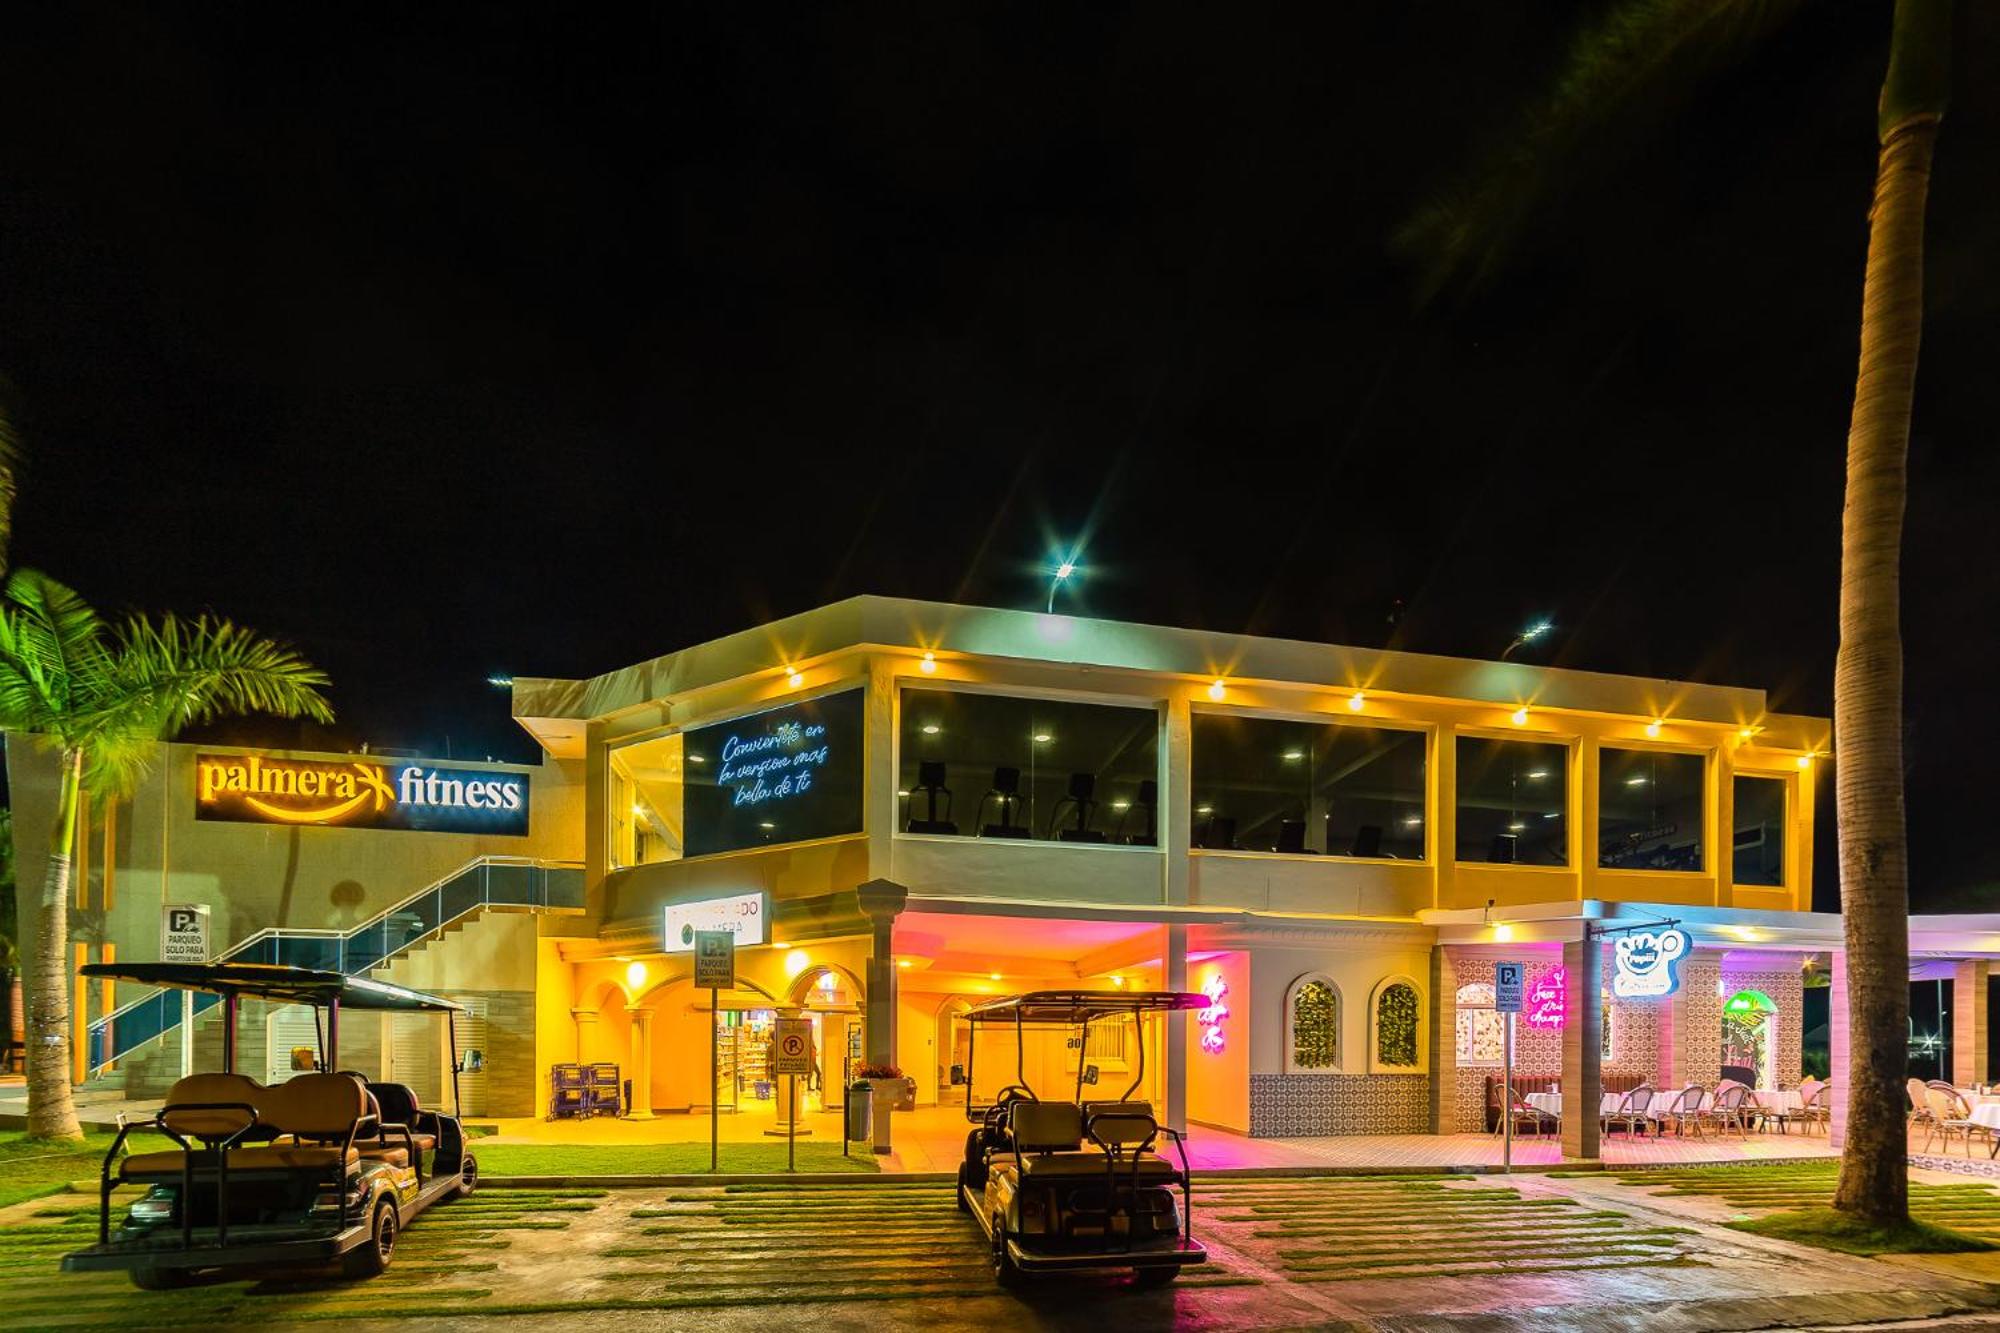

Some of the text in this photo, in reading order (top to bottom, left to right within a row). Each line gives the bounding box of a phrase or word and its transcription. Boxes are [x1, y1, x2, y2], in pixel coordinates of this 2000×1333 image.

[805, 725, 825, 737] en
[793, 746, 828, 765] mas
[200, 757, 520, 811] palmera fitness
[735, 769, 811, 805] bella de ti
[176, 913, 190, 929] P
[168, 935, 202, 945] PARQUEO
[165, 945, 185, 954] SOLO
